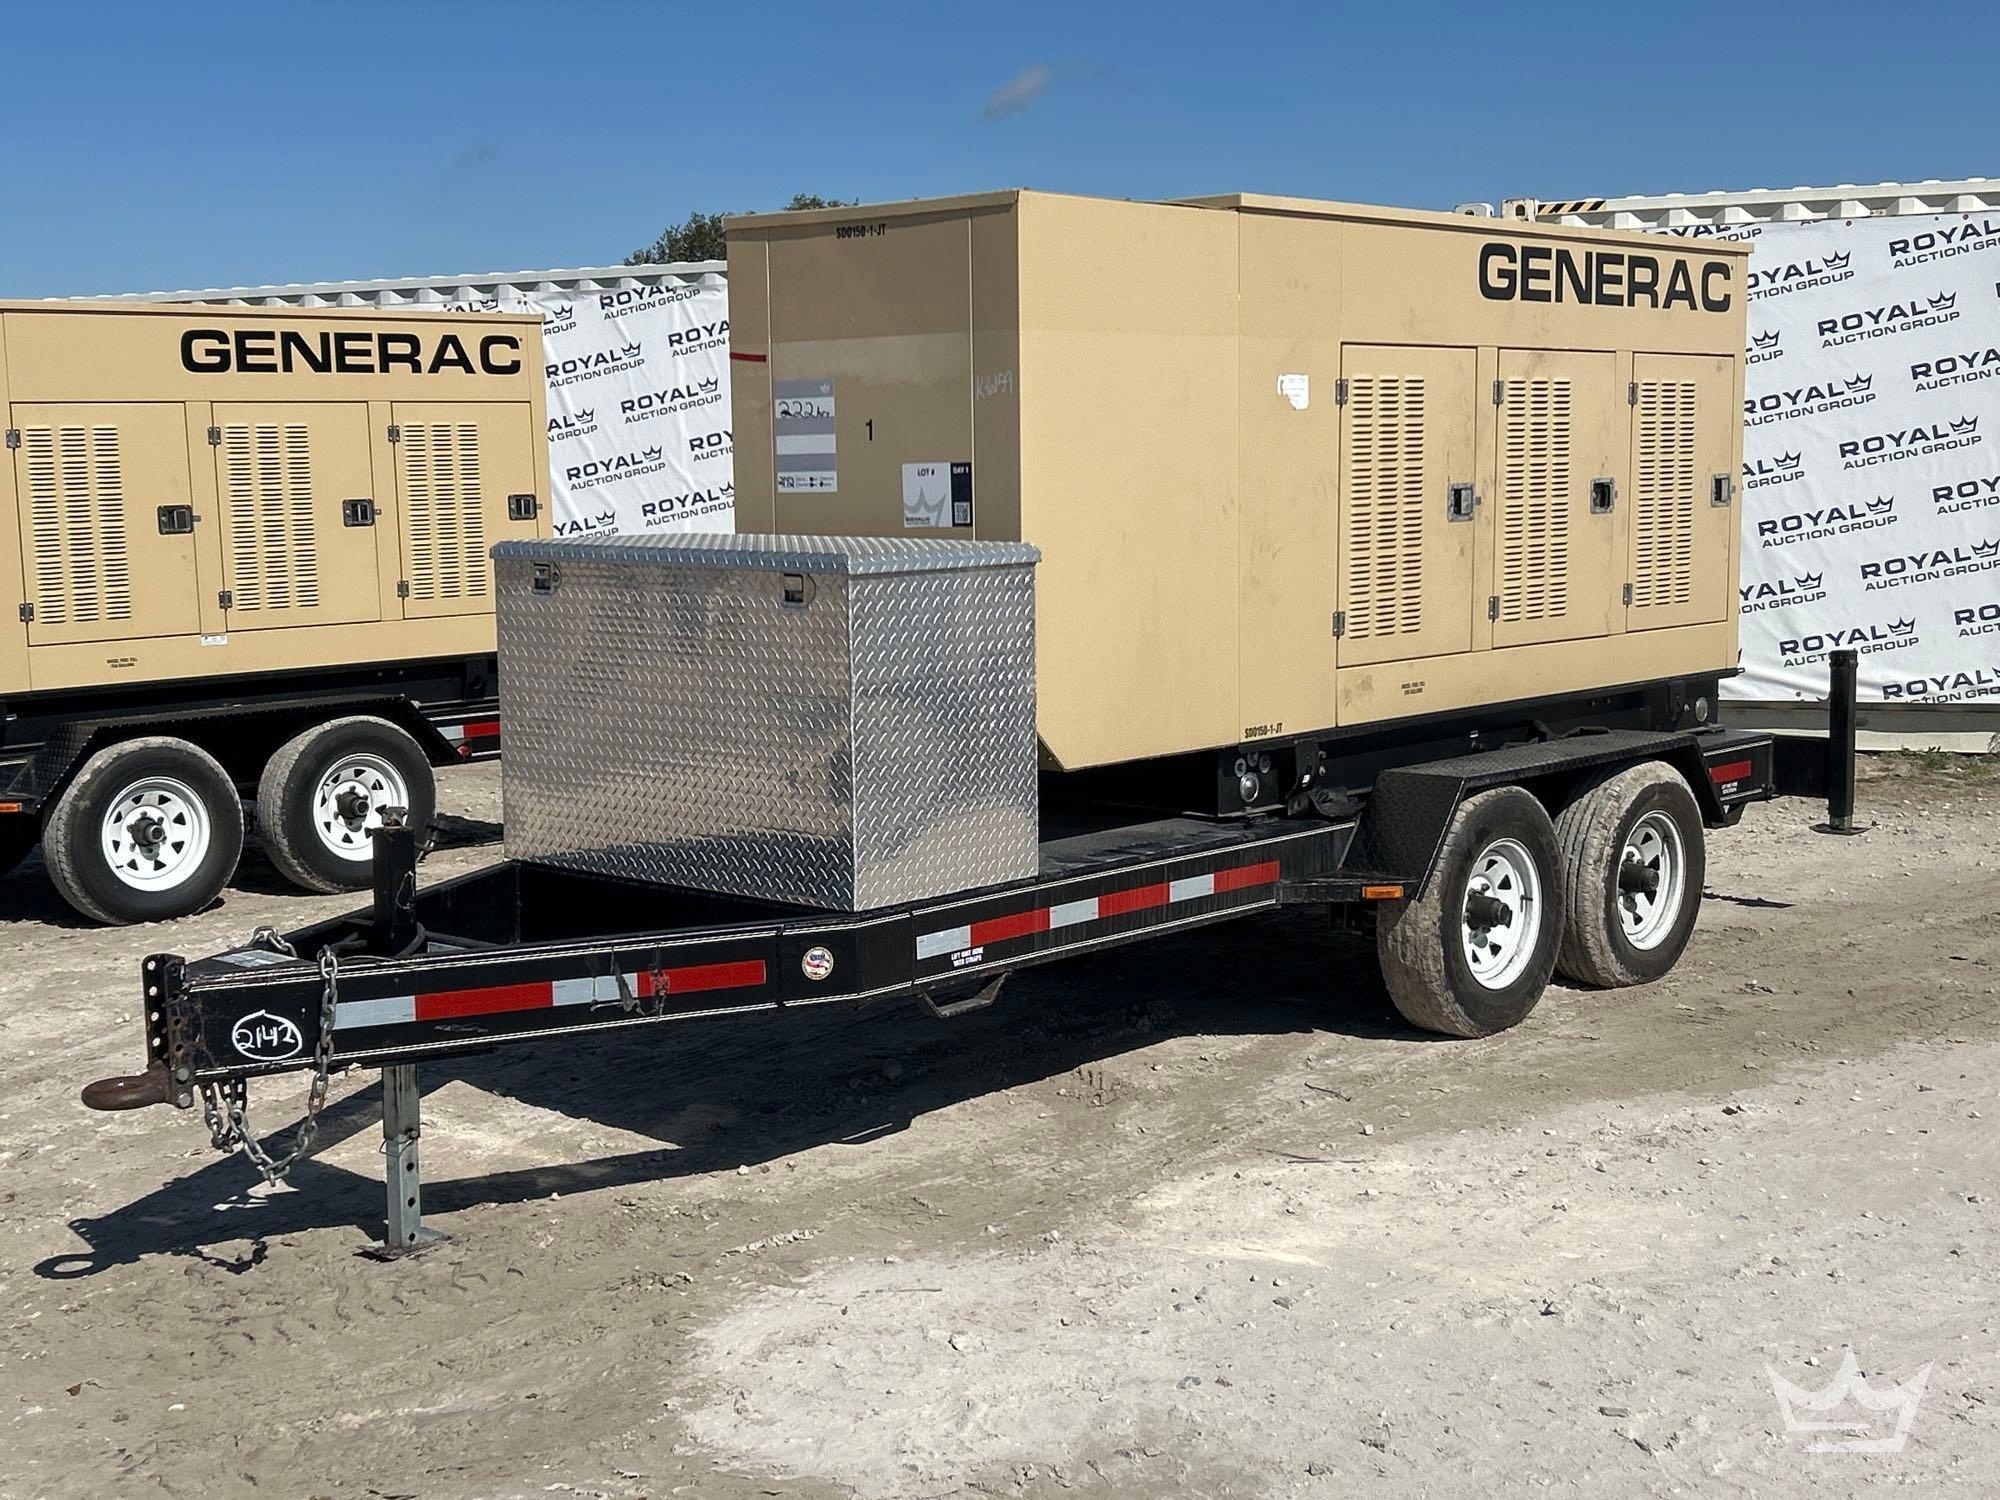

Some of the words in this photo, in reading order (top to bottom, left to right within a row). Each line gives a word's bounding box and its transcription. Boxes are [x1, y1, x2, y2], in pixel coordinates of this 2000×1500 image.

[1717, 228, 1762, 242] OUP
[1889, 220, 2000, 257] ROYAL
[1893, 244, 1970, 269] AUCTION
[1480, 243, 1731, 312] GENERAC
[1747, 260, 1823, 289] OYAL
[1747, 285, 1792, 302] CTION
[1796, 270, 1855, 290] GROUP
[600, 285, 677, 310] ROYAL
[603, 300, 656, 320] AUCTION
[658, 288, 701, 306] GROUP
[544, 321, 577, 336] ROUP
[1817, 301, 1928, 336] ROYAL
[1822, 325, 1897, 349] AUCTION
[1900, 311, 1960, 331] GROUP
[668, 320, 730, 347] ROYA
[672, 337, 726, 358] AUCTION
[180, 329, 521, 375] GENERAC
[545, 349, 622, 379] ROYAL
[1745, 349, 1784, 365] OUP
[1911, 349, 2000, 380] ROYA
[549, 370, 601, 389] AUCTION
[603, 358, 645, 375] GROUP
[1915, 369, 1992, 392] AUCTION
[620, 384, 699, 414] ROYAL
[624, 404, 678, 424] AUCTION
[679, 393, 722, 411] GROUP
[1744, 382, 1845, 415] ROYAL
[1744, 405, 1814, 428] AUCTION
[1817, 393, 1876, 412] GROUP
[557, 424, 598, 441] GROUP
[689, 430, 733, 452] ROY
[865, 419, 874, 441] 1
[1839, 424, 1950, 458] ROYAL
[566, 452, 644, 481] ROYAL
[693, 446, 734, 462] AUCTI
[1843, 448, 1918, 471] AUCTION
[1922, 435, 1982, 455] GROUP
[570, 472, 623, 491] AUCTION
[624, 462, 666, 479] GROUP
[917, 468, 930, 477] LOT
[1747, 470, 1805, 489] GROUP
[642, 489, 720, 517] ROYAL
[1932, 475, 2000, 503] ROY
[645, 508, 699, 527] AUCTION
[701, 500, 735, 515] GROU
[1937, 495, 2000, 515] AUCTIO
[553, 517, 597, 536] YAL
[1758, 504, 1866, 537] ROYAL
[1762, 526, 1836, 548] AUCTION
[1838, 515, 1898, 534] GROUP
[1860, 547, 1972, 580] ROYAL
[1739, 580, 1796, 601] YAL
[1865, 570, 1940, 592] AUCTION
[1769, 591, 1827, 609] GROUP
[1779, 625, 1888, 656] ROYAL
[1959, 623, 2000, 638] AUCT
[1860, 637, 1919, 655] GROUP
[1882, 670, 1993, 700] ROYAL
[1965, 686, 2000, 699] GRO
[235, 1024, 296, 1050] 2142
